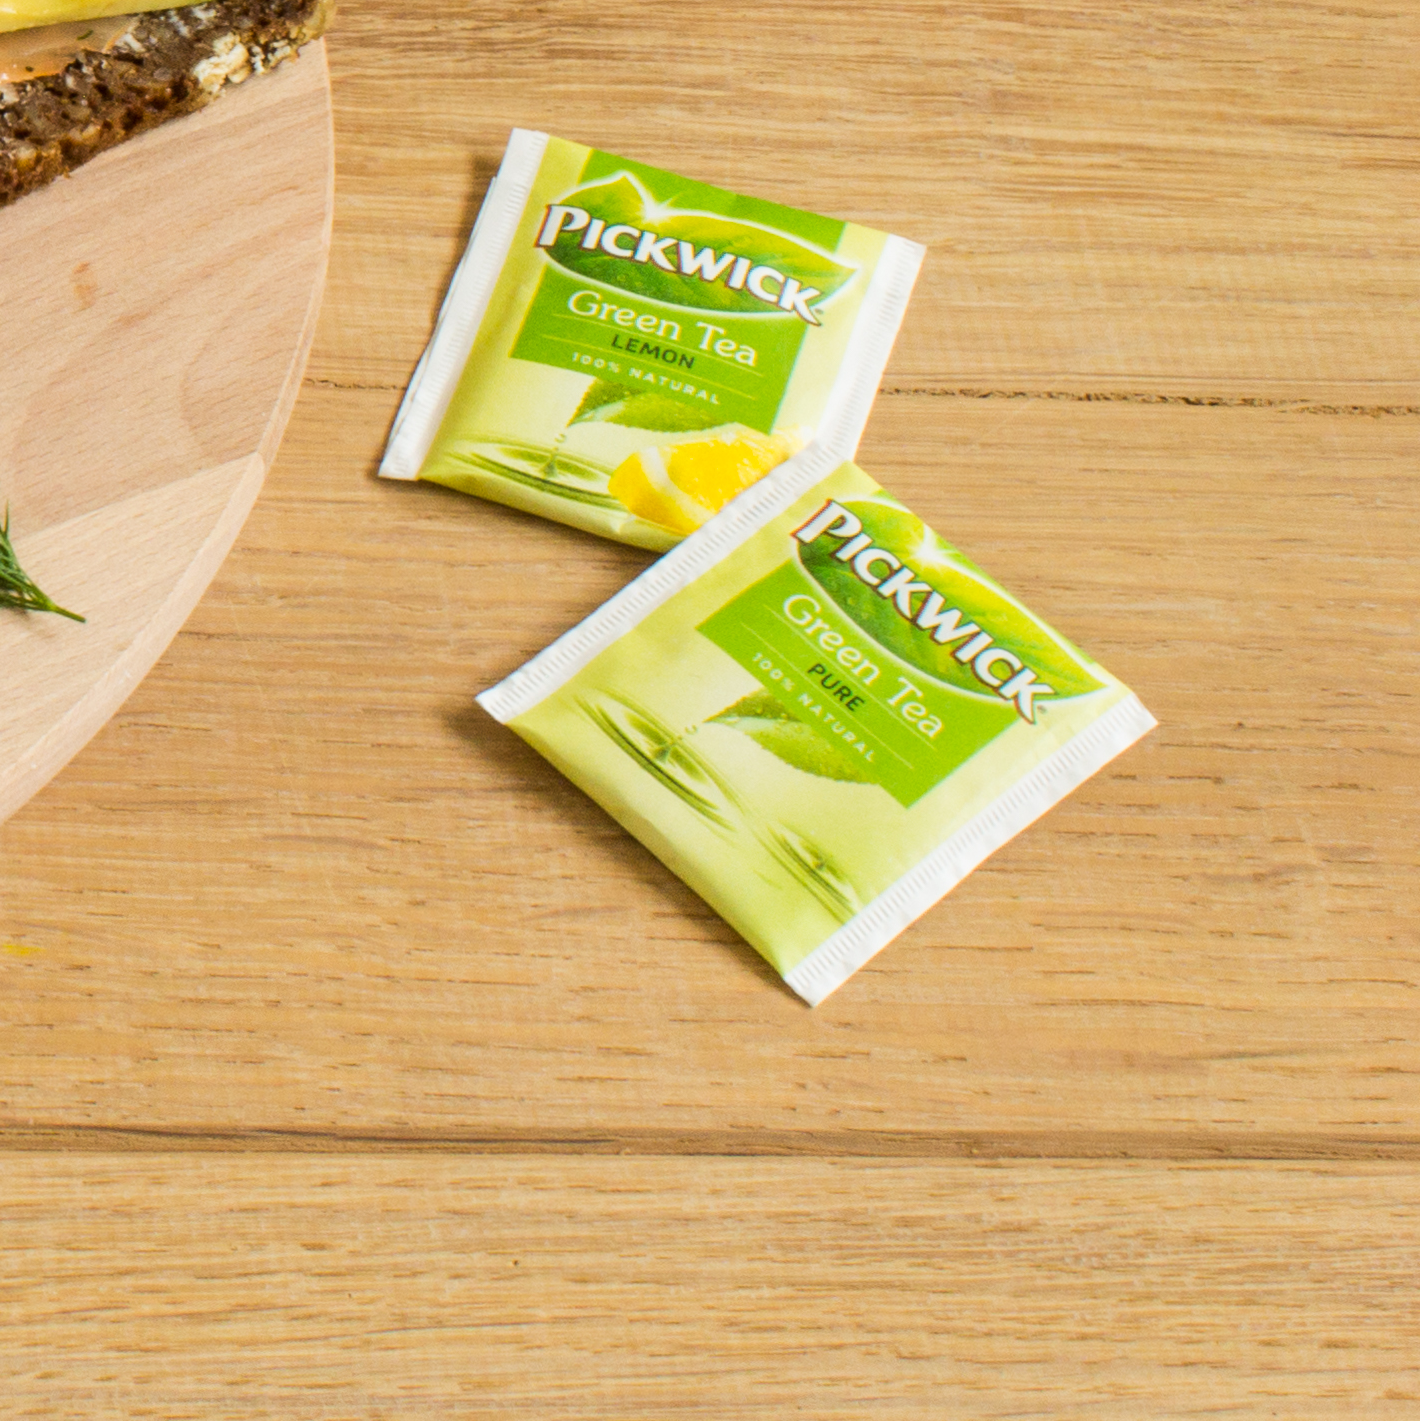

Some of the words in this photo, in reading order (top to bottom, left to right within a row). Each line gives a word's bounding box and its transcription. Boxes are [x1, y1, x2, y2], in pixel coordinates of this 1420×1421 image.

[534, 204, 823, 326] PICKWICK
[567, 289, 682, 342] Green
[697, 322, 758, 367] Tea
[611, 334, 695, 370] LEMON
[572, 351, 621, 375] 100%
[628, 367, 720, 405] NATURAL
[791, 498, 1055, 725] PICKWICK
[751, 652, 796, 692] 100%
[796, 692, 876, 764] NATURAL
[783, 594, 881, 688] Green
[887, 676, 944, 740] Tea
[806, 661, 866, 714] PURE
